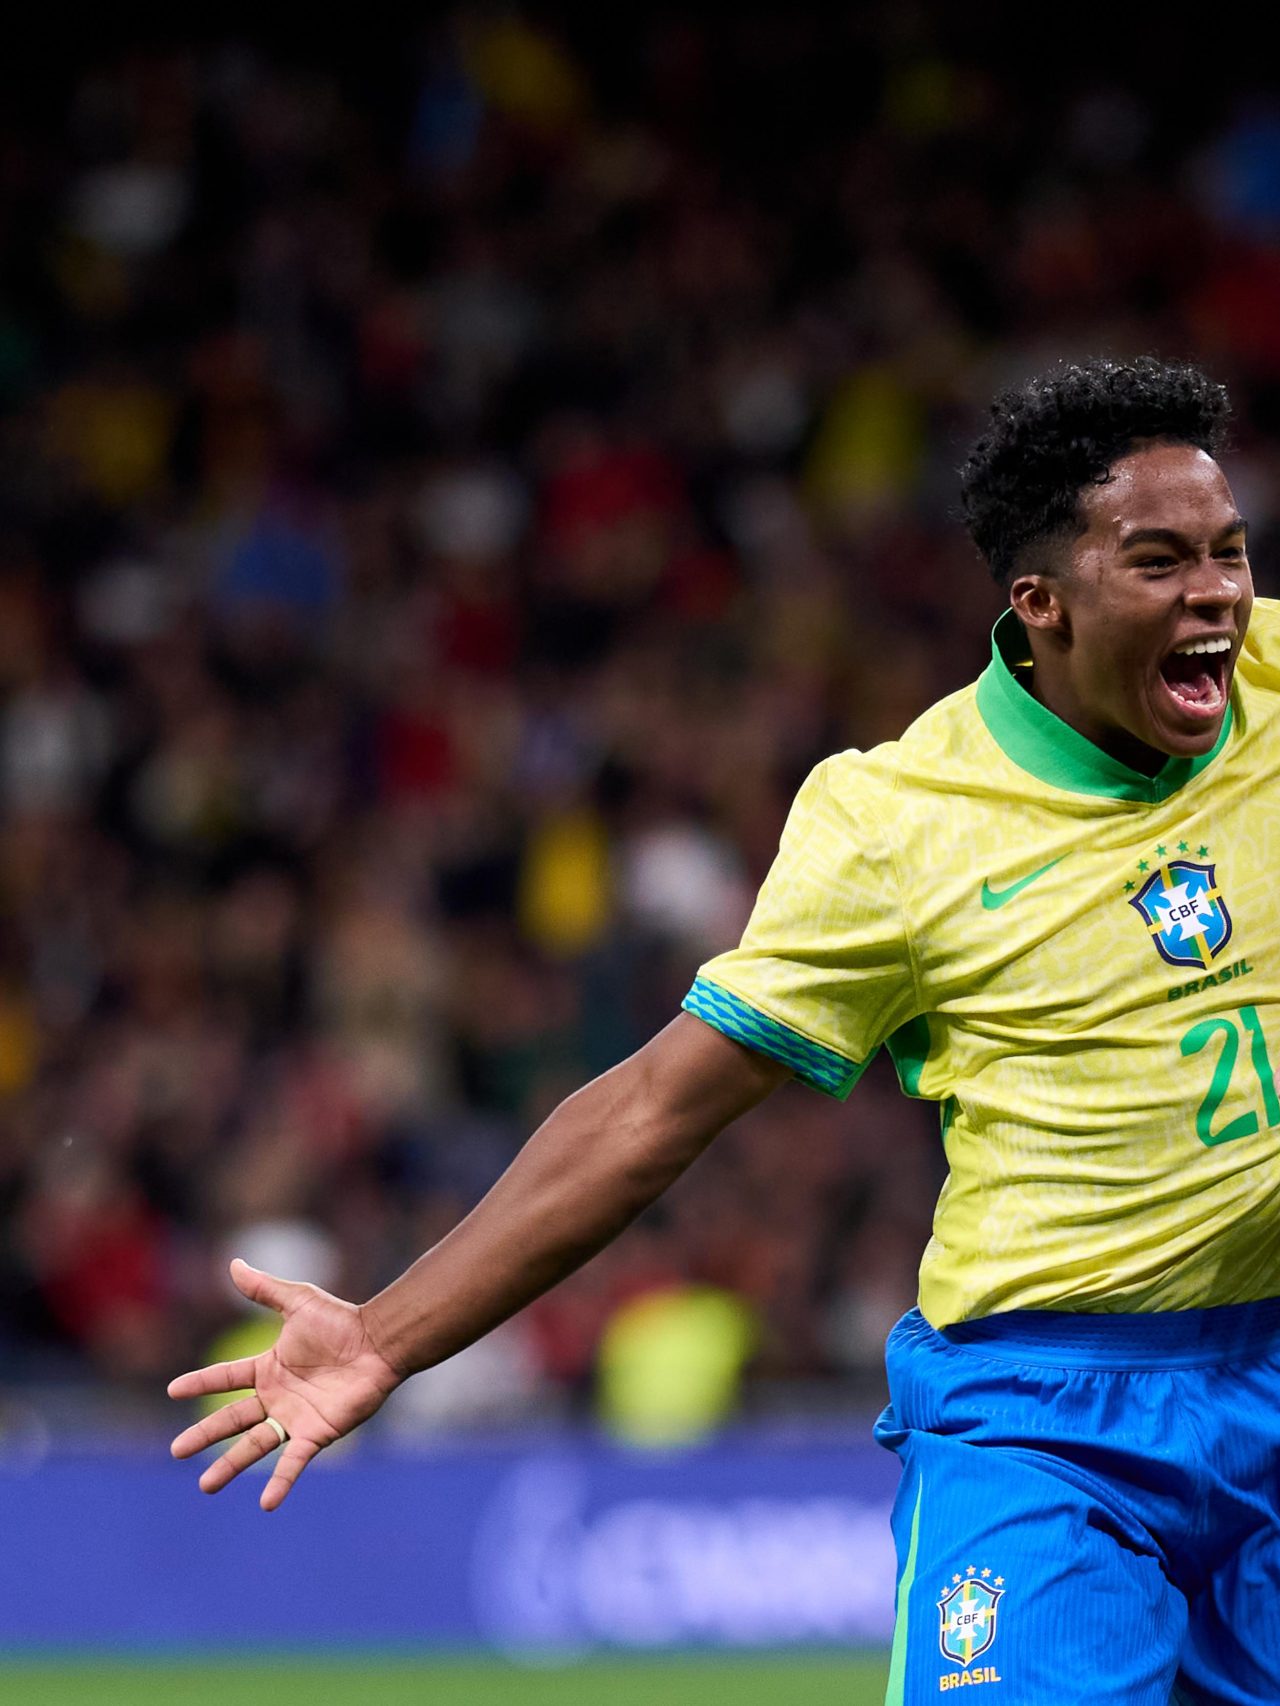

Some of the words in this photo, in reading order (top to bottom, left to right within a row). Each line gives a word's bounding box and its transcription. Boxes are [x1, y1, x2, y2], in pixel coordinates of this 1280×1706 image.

[1168, 900, 1199, 923] CBF
[1168, 958, 1254, 1001] BRASIL
[956, 1613, 979, 1626] CBF
[939, 1667, 1001, 1692] BRASIL
